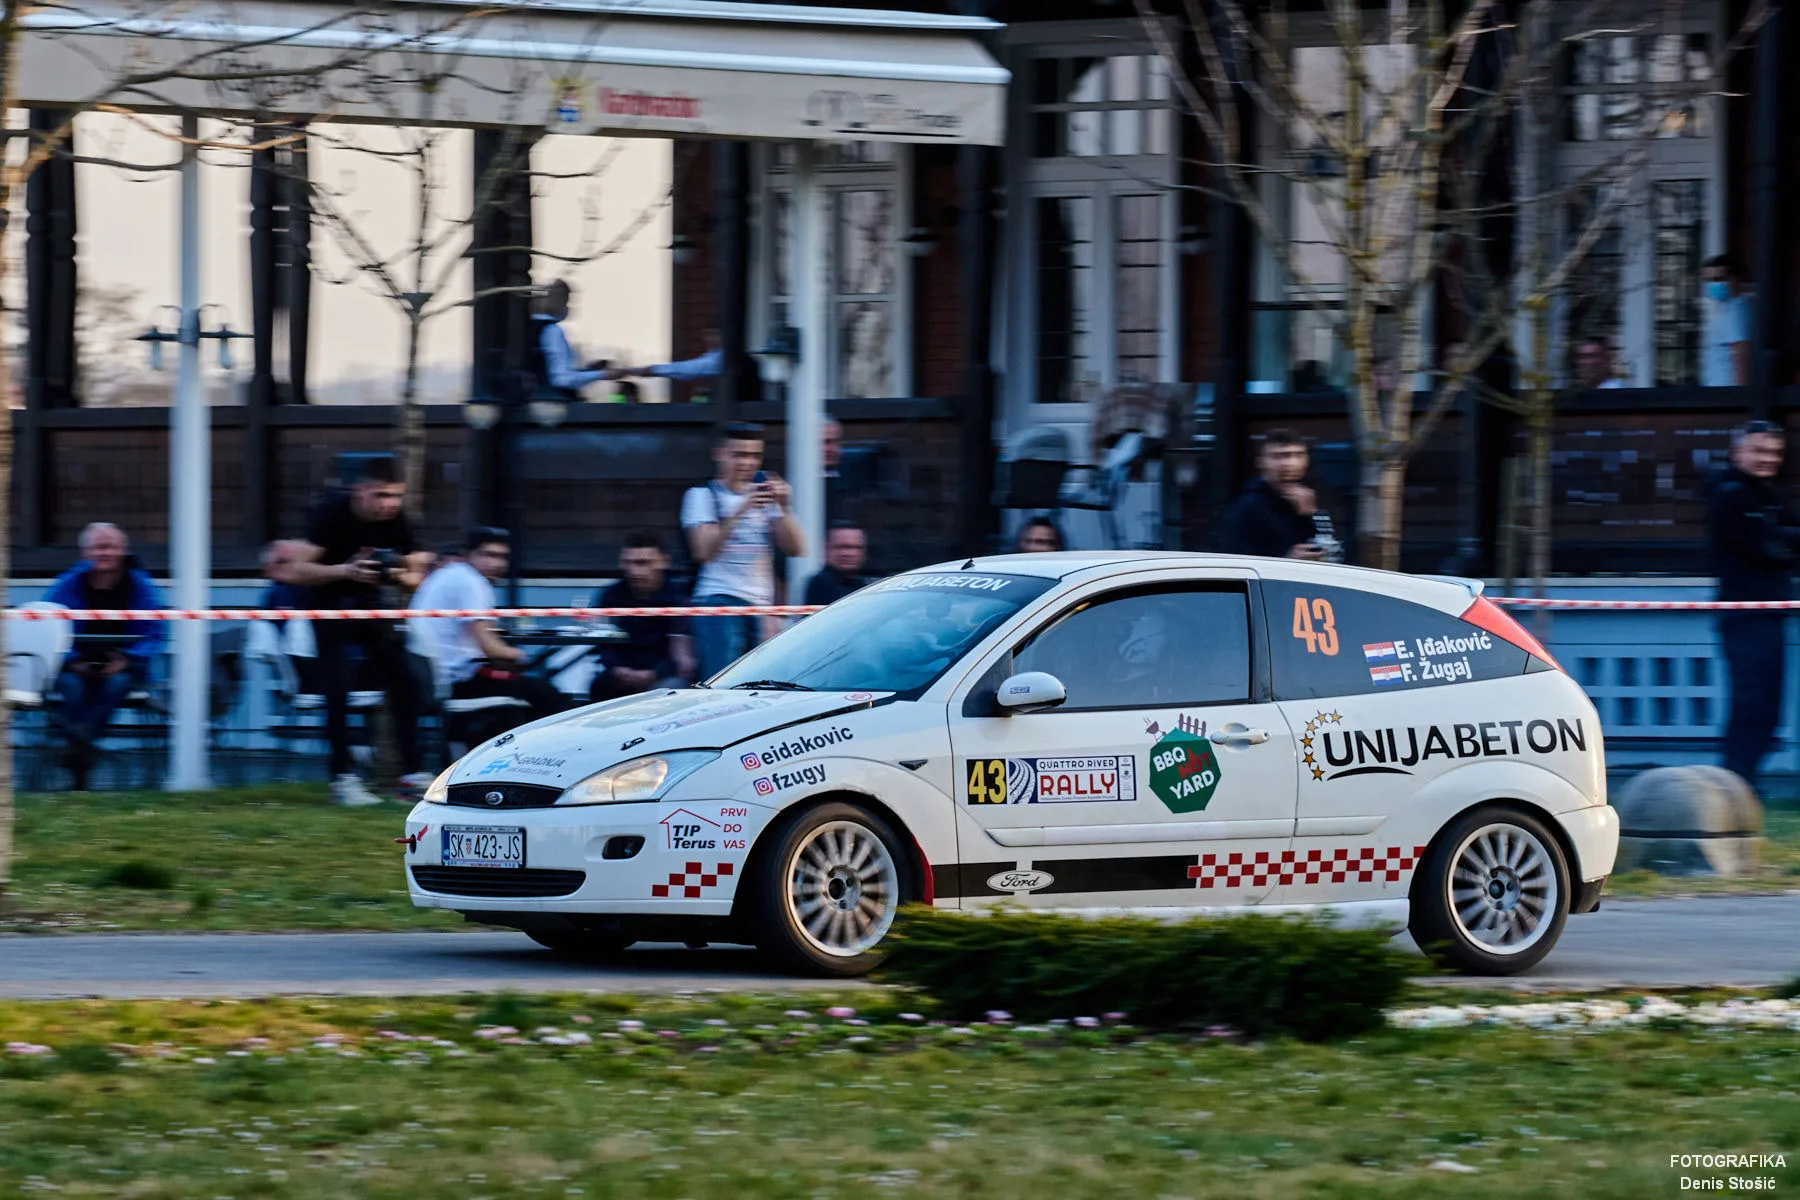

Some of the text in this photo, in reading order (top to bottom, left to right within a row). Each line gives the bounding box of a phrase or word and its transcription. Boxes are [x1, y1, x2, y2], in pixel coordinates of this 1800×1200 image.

[1292, 597, 1340, 657] 43
[1393, 631, 1493, 659] E. Iđaković
[1400, 656, 1474, 682] F. Žugaj
[761, 726, 854, 765] eidakovic
[1322, 718, 1587, 767] UNIJABETON
[1040, 759, 1115, 769] QUATTRO RIVER
[1153, 746, 1187, 772] BBQ
[772, 764, 826, 791] fzugy
[968, 759, 1006, 804] 43
[1040, 772, 1115, 796] RALLY
[1169, 770, 1215, 799] YARD
[720, 808, 747, 817] PRVI
[673, 825, 701, 837] TIP
[723, 824, 742, 833] DO
[450, 833, 465, 859] SK
[673, 837, 716, 849] Terus
[723, 840, 746, 849] VAS
[1000, 873, 1041, 888] Ford
